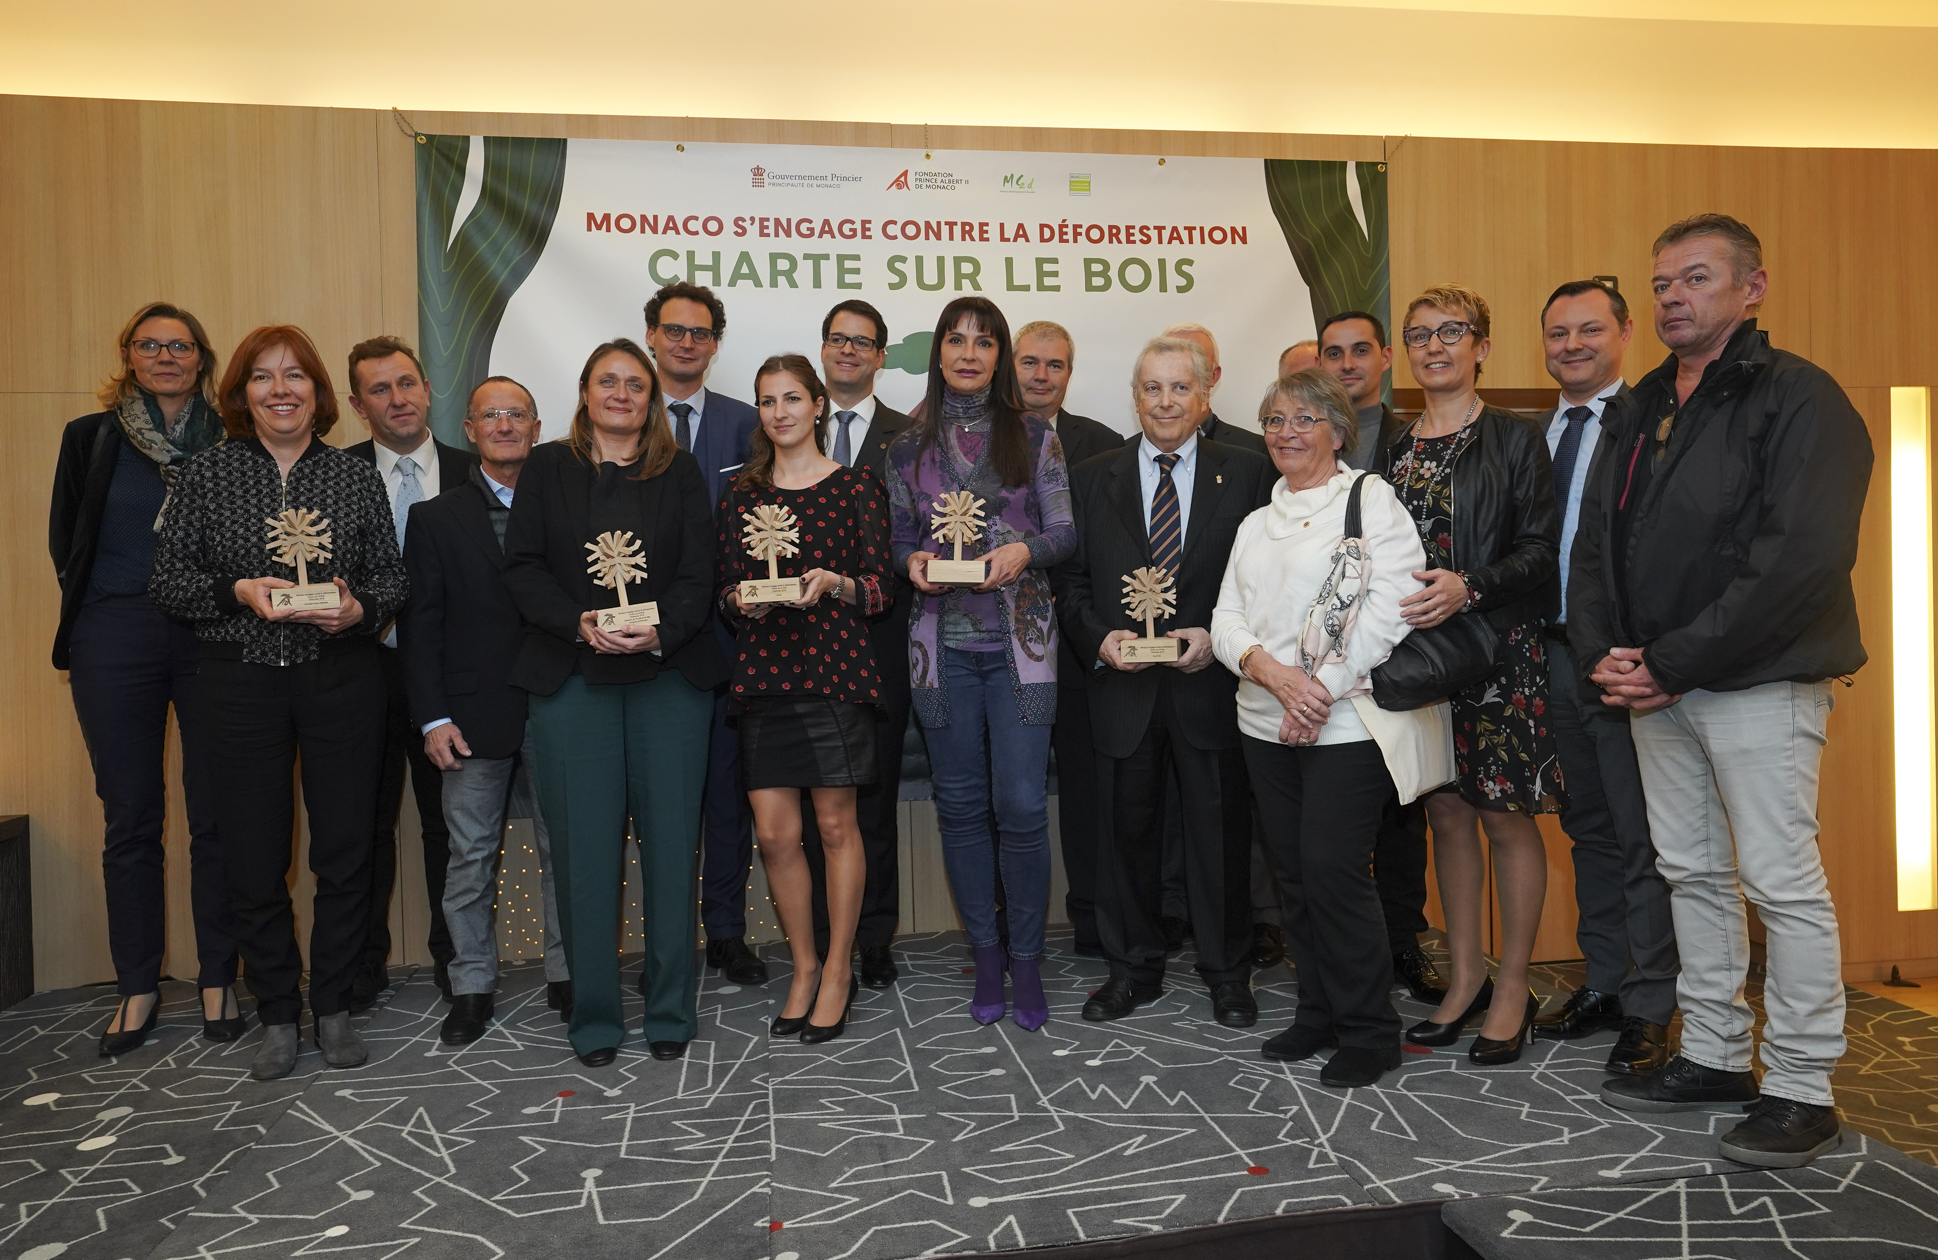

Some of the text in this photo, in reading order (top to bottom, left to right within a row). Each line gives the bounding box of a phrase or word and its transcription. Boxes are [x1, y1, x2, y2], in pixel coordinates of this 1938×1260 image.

[767, 171, 863, 182] Gouvernement Princier
[586, 212, 724, 237] MONACO
[881, 219, 990, 242] CONTRE
[999, 222, 1031, 243] LA
[1039, 219, 1248, 245] DÉFORESTATION
[648, 248, 1195, 293] CHARTE SUR LE BOIS
